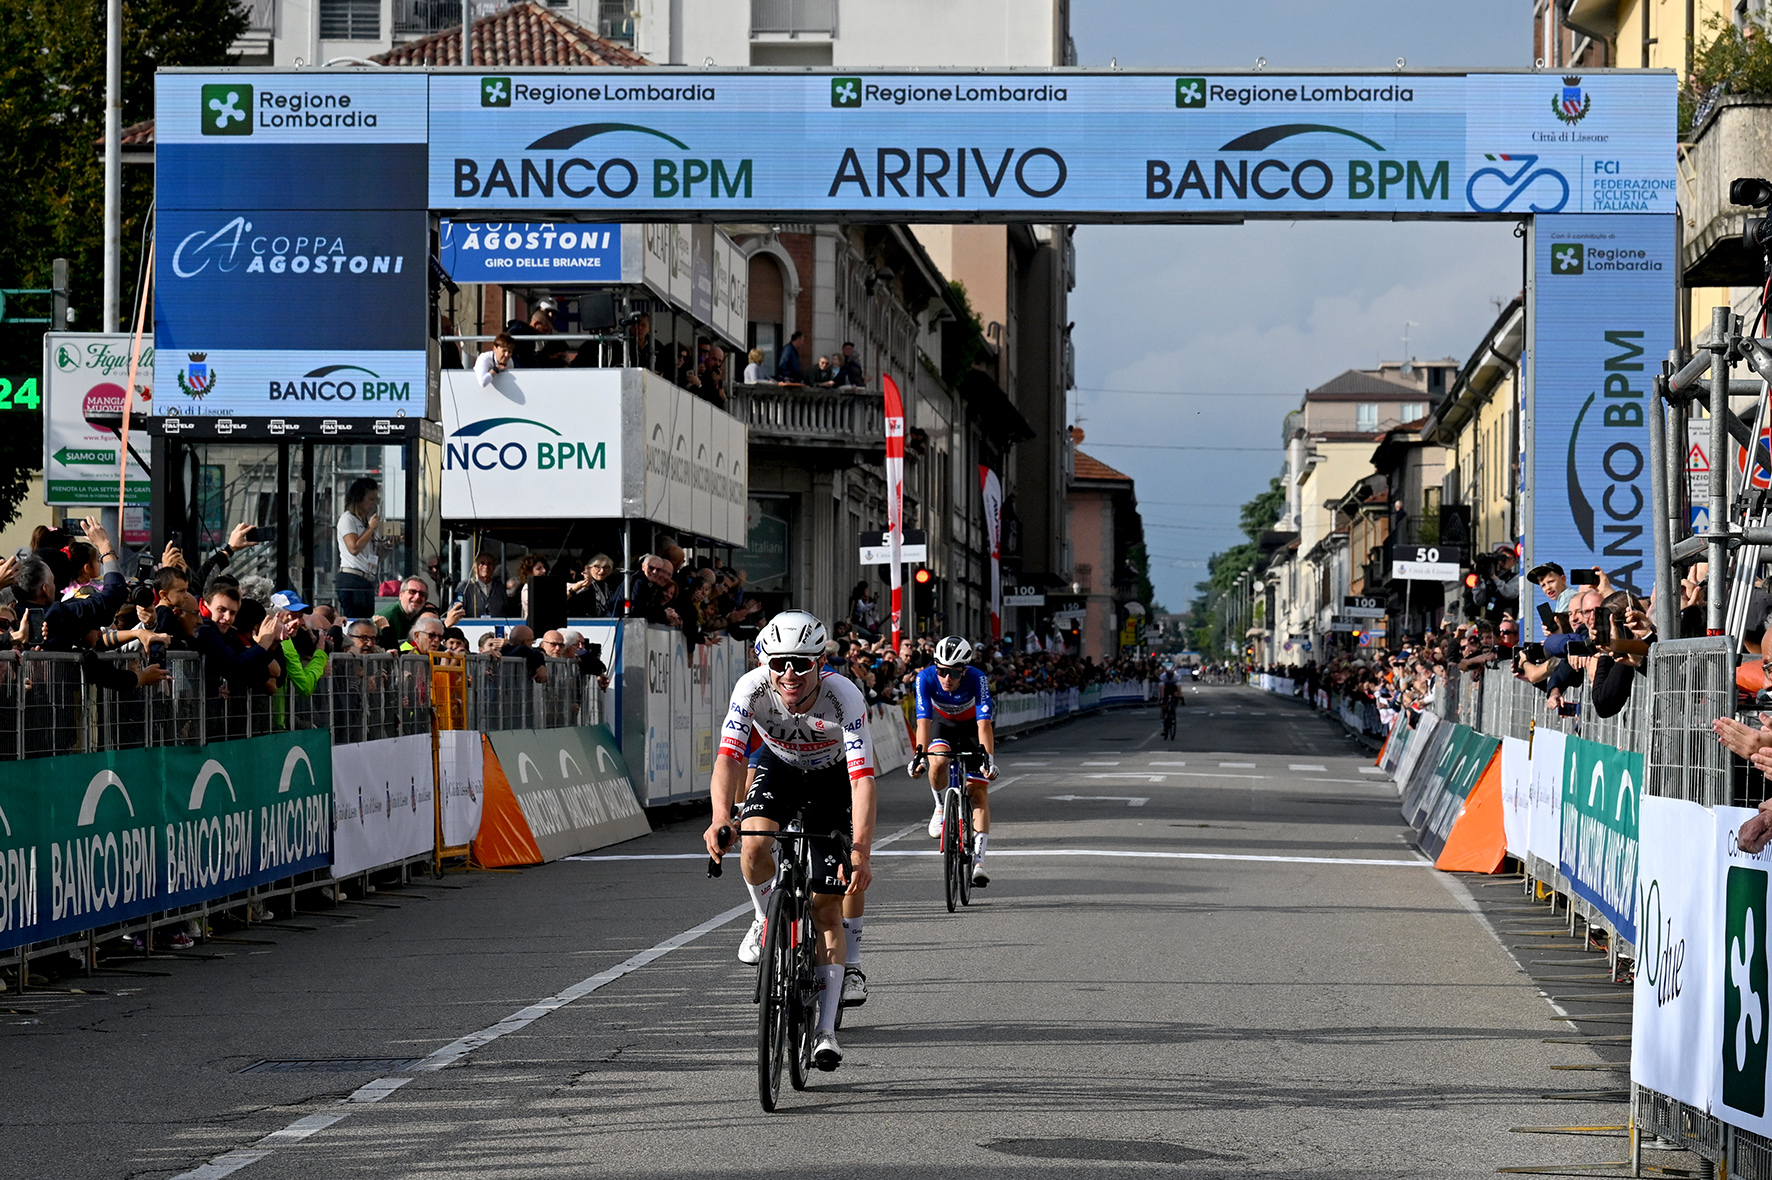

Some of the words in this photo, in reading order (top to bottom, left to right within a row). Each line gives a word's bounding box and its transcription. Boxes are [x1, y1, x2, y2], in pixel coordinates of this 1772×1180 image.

[260, 91, 351, 111] Regione
[515, 84, 601, 104] Regione
[604, 84, 715, 101] Lombardia
[865, 84, 952, 105] Regione
[956, 84, 1068, 102] Lombardia
[1210, 84, 1297, 105] Regione
[1301, 85, 1414, 102] Lombardia
[259, 112, 377, 128] Lombardia
[1532, 131, 1556, 142] Città
[1559, 131, 1569, 142] di
[1571, 132, 1609, 142] Lissone
[827, 147, 1068, 198] ARRIVO
[1594, 161, 1620, 174] FCI
[454, 157, 639, 199] BANCO
[653, 158, 753, 198] BPM
[1146, 159, 1333, 200] BANCO
[1348, 160, 1449, 200] BPM
[1593, 179, 1676, 190] FEDERAZIONE
[1593, 190, 1658, 200] CICLISTICA
[1593, 201, 1649, 211] ITALIANA
[251, 236, 345, 255] COPPA
[462, 232, 611, 250] AGOSTONI
[485, 258, 513, 268] GIRO
[516, 258, 550, 267] DELLE
[553, 258, 601, 267] BRIANZE
[1588, 248, 1646, 261] Regione
[246, 255, 404, 274] AGOSTONI
[1587, 260, 1662, 271] Lombardia
[1604, 331, 1645, 427] BPM
[269, 381, 356, 401] BANCO
[362, 382, 410, 401] BPM
[184, 404, 194, 416] di
[66, 453, 95, 461] SIAMO
[97, 453, 114, 462] QUI
[440, 442, 527, 471] NCO
[537, 442, 606, 469] BPM
[1602, 442, 1645, 597] ANCO
[751, 541, 783, 553] Italiani
[1415, 547, 1439, 563] 50
[1013, 586, 1035, 596] 100
[1354, 598, 1376, 608] 100
[767, 726, 828, 743] UAE
[845, 739, 863, 752] DQ
[259, 797, 304, 871] BANCO
[306, 793, 329, 855] BPM
[166, 816, 222, 894] BANCO
[224, 810, 253, 881] BPM
[1728, 830, 1742, 858] Co
[51, 831, 119, 921] BANCO
[122, 826, 156, 904] BPM
